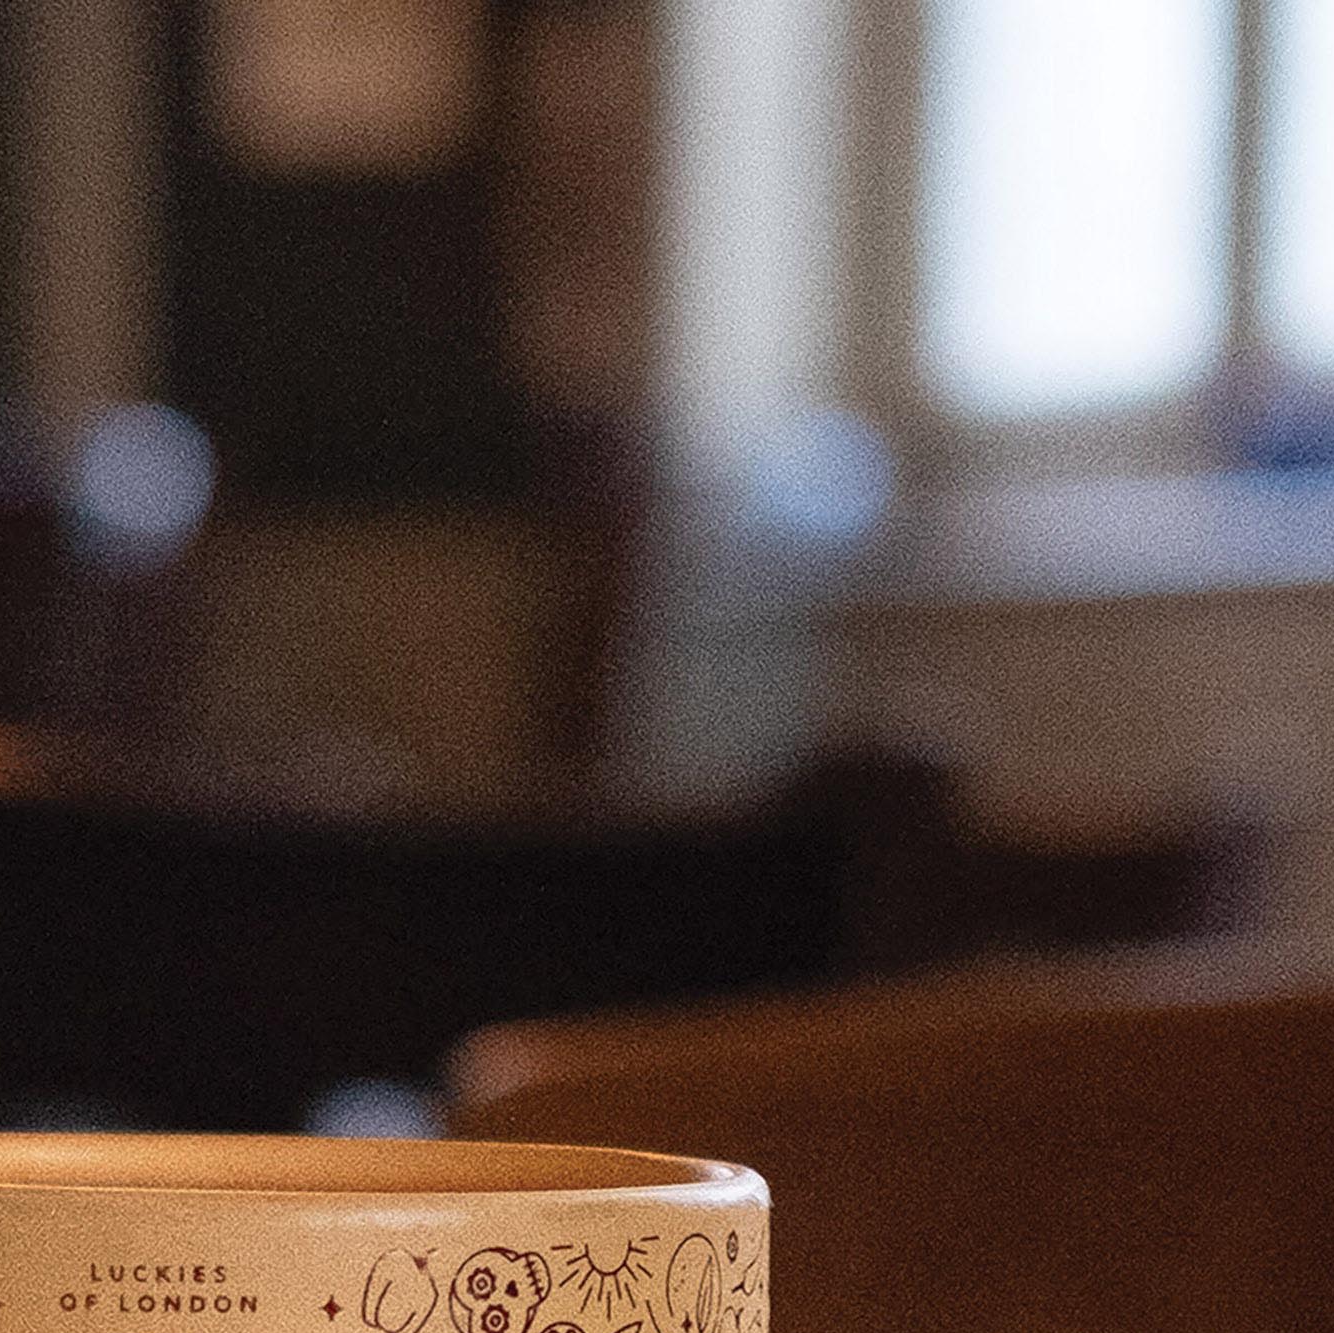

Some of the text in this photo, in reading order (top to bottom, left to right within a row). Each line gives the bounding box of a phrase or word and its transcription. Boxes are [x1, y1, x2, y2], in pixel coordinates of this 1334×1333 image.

[90, 1263, 227, 1284] LUCKIES
[60, 1292, 259, 1314] OF LONDON
